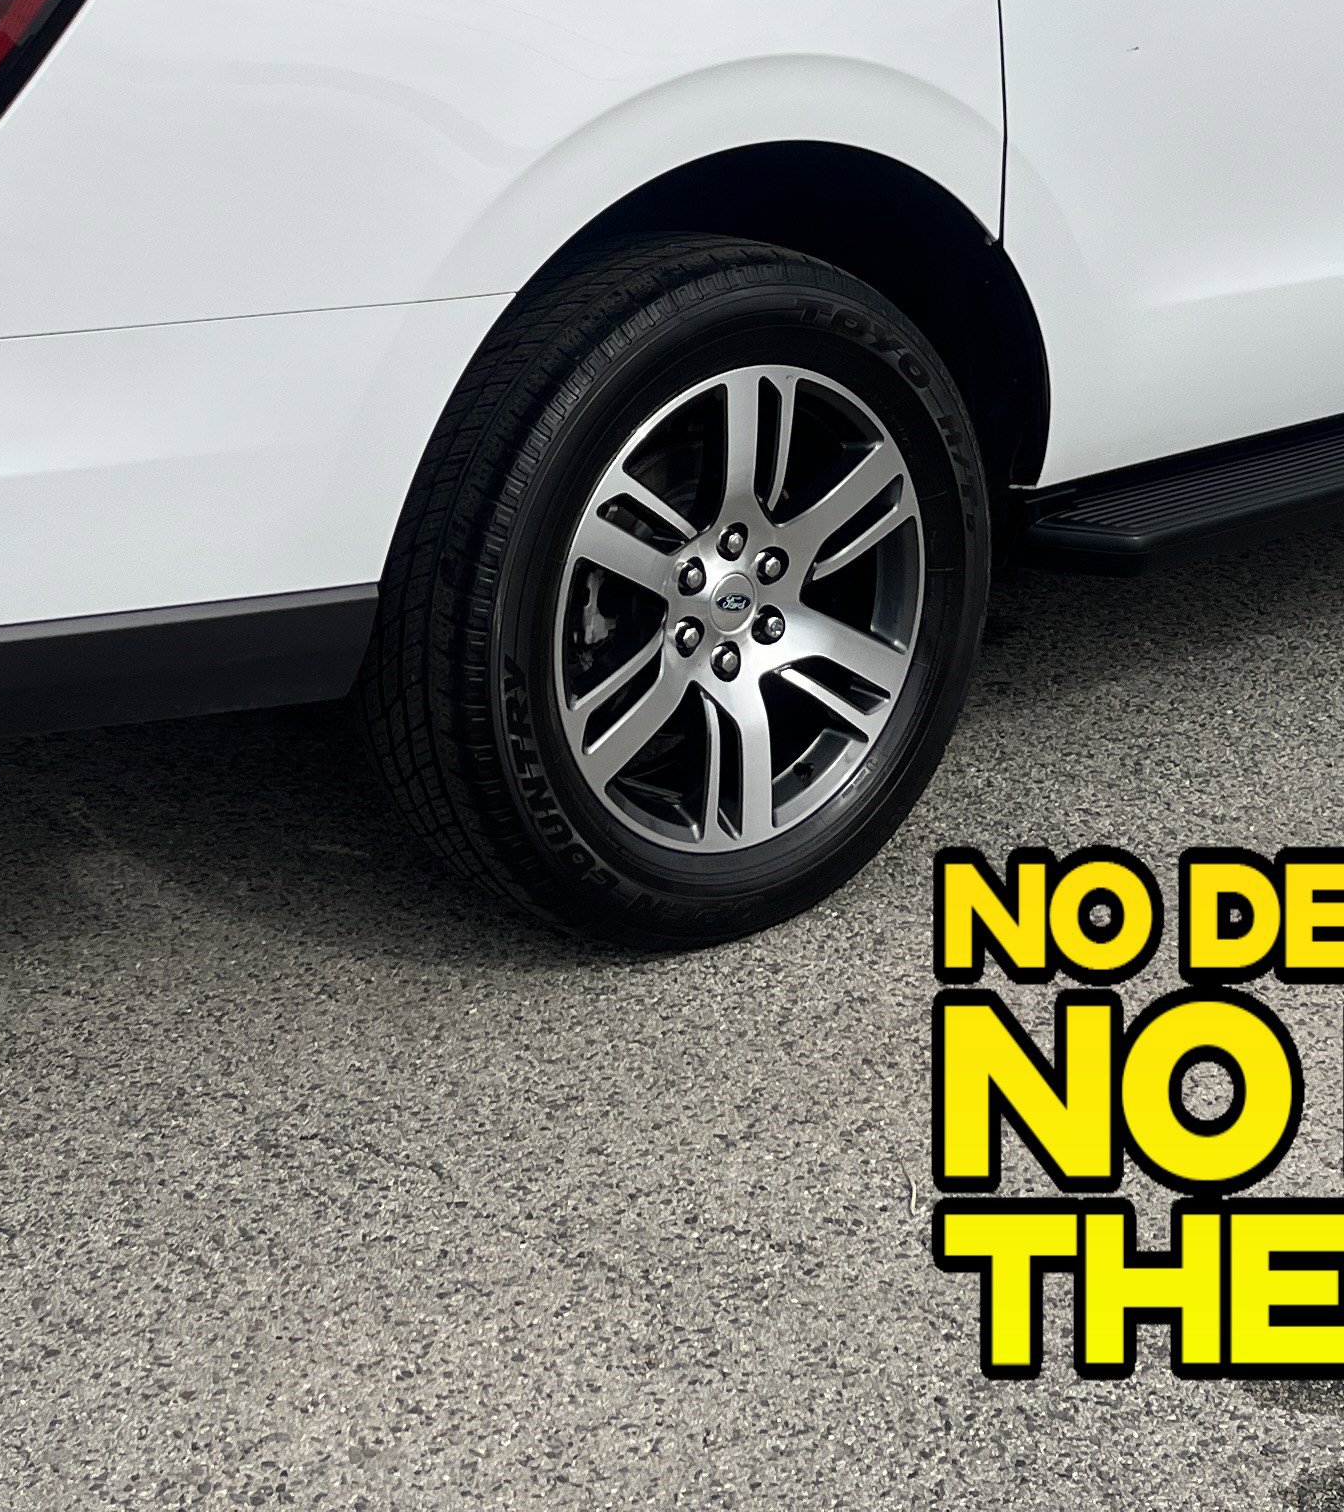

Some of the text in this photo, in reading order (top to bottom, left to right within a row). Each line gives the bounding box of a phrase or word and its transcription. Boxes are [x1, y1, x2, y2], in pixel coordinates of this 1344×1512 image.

[794, 295, 932, 390] TOYO
[722, 593, 747, 609] Ford
[503, 652, 620, 890] COUNTRY
